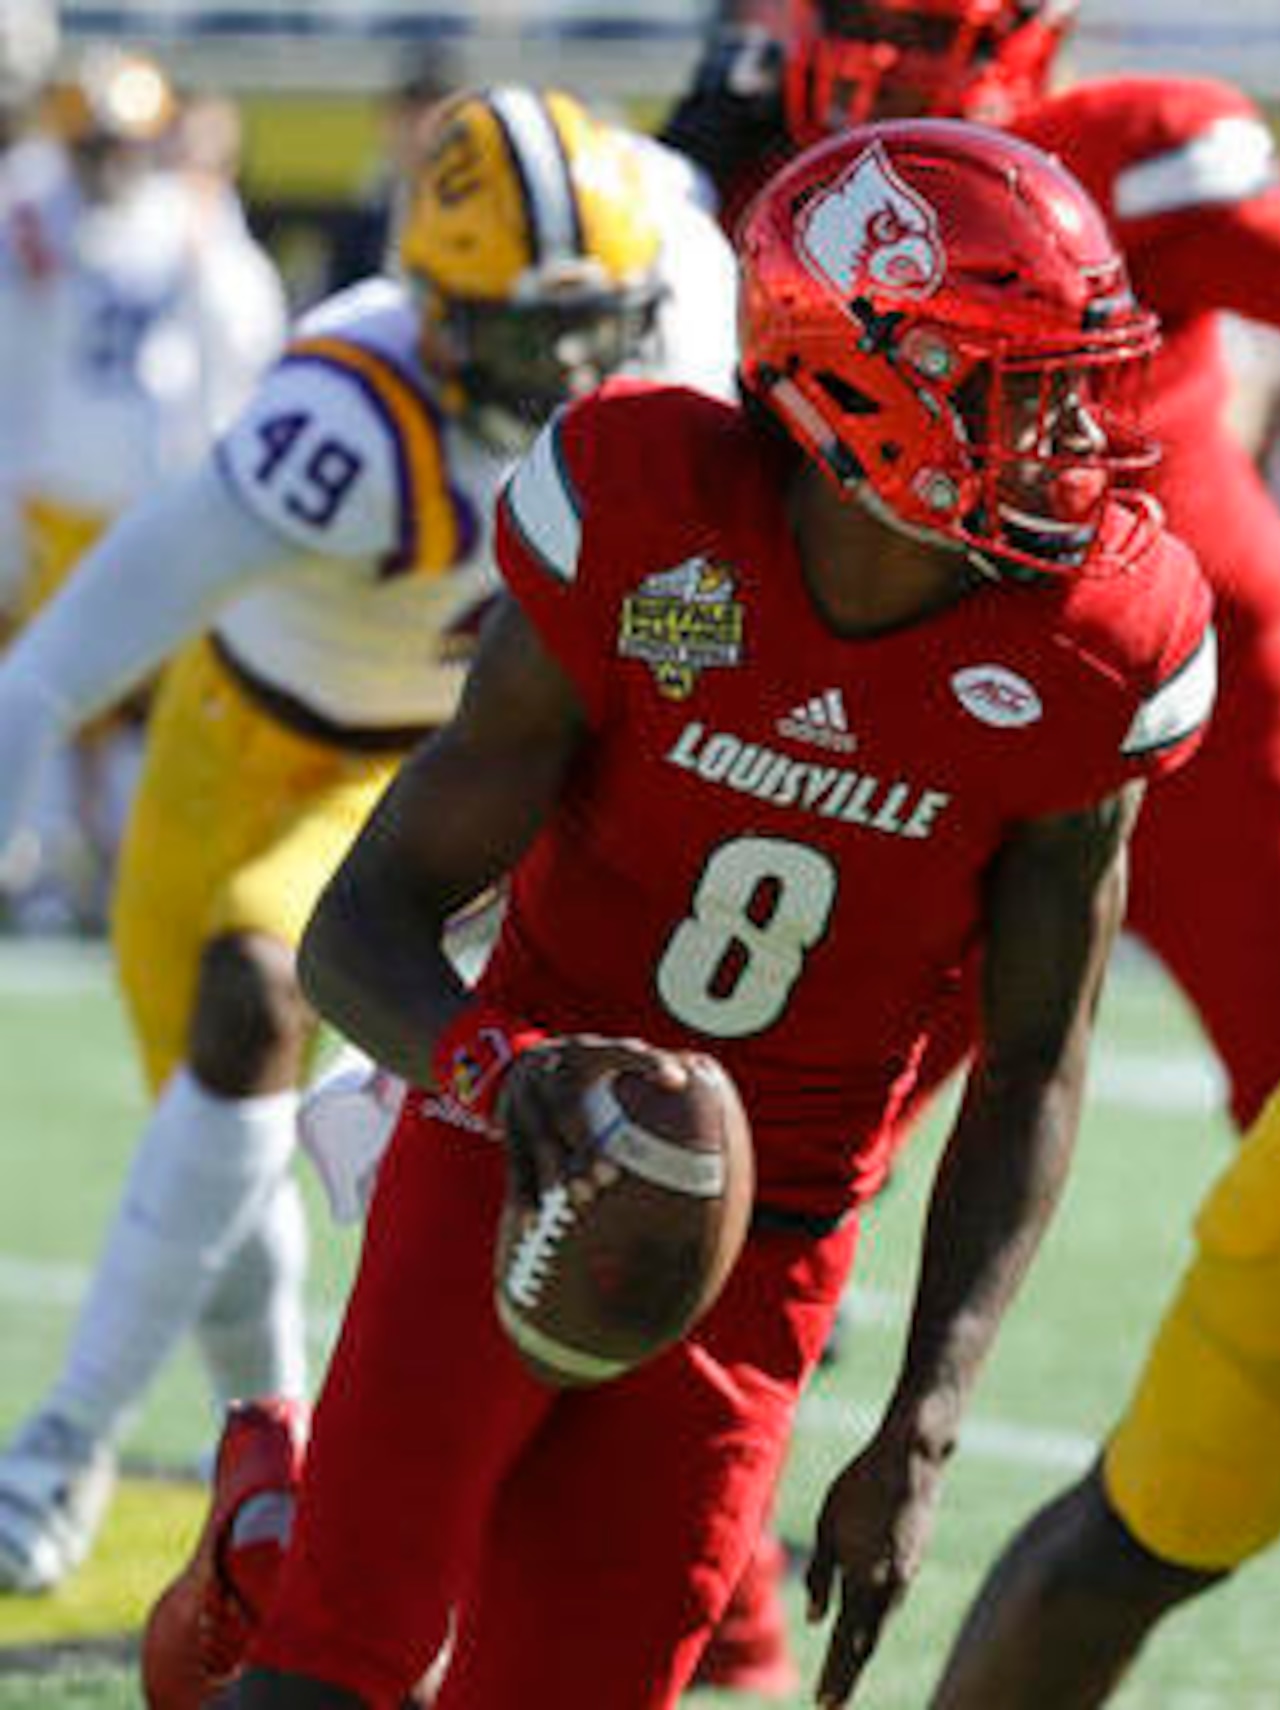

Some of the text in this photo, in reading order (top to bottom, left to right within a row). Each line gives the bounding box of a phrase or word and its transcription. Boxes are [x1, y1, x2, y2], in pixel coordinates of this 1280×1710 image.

[254, 412, 366, 532] 49
[666, 722, 949, 839] LOUISVILLE
[655, 836, 838, 1038] 8
